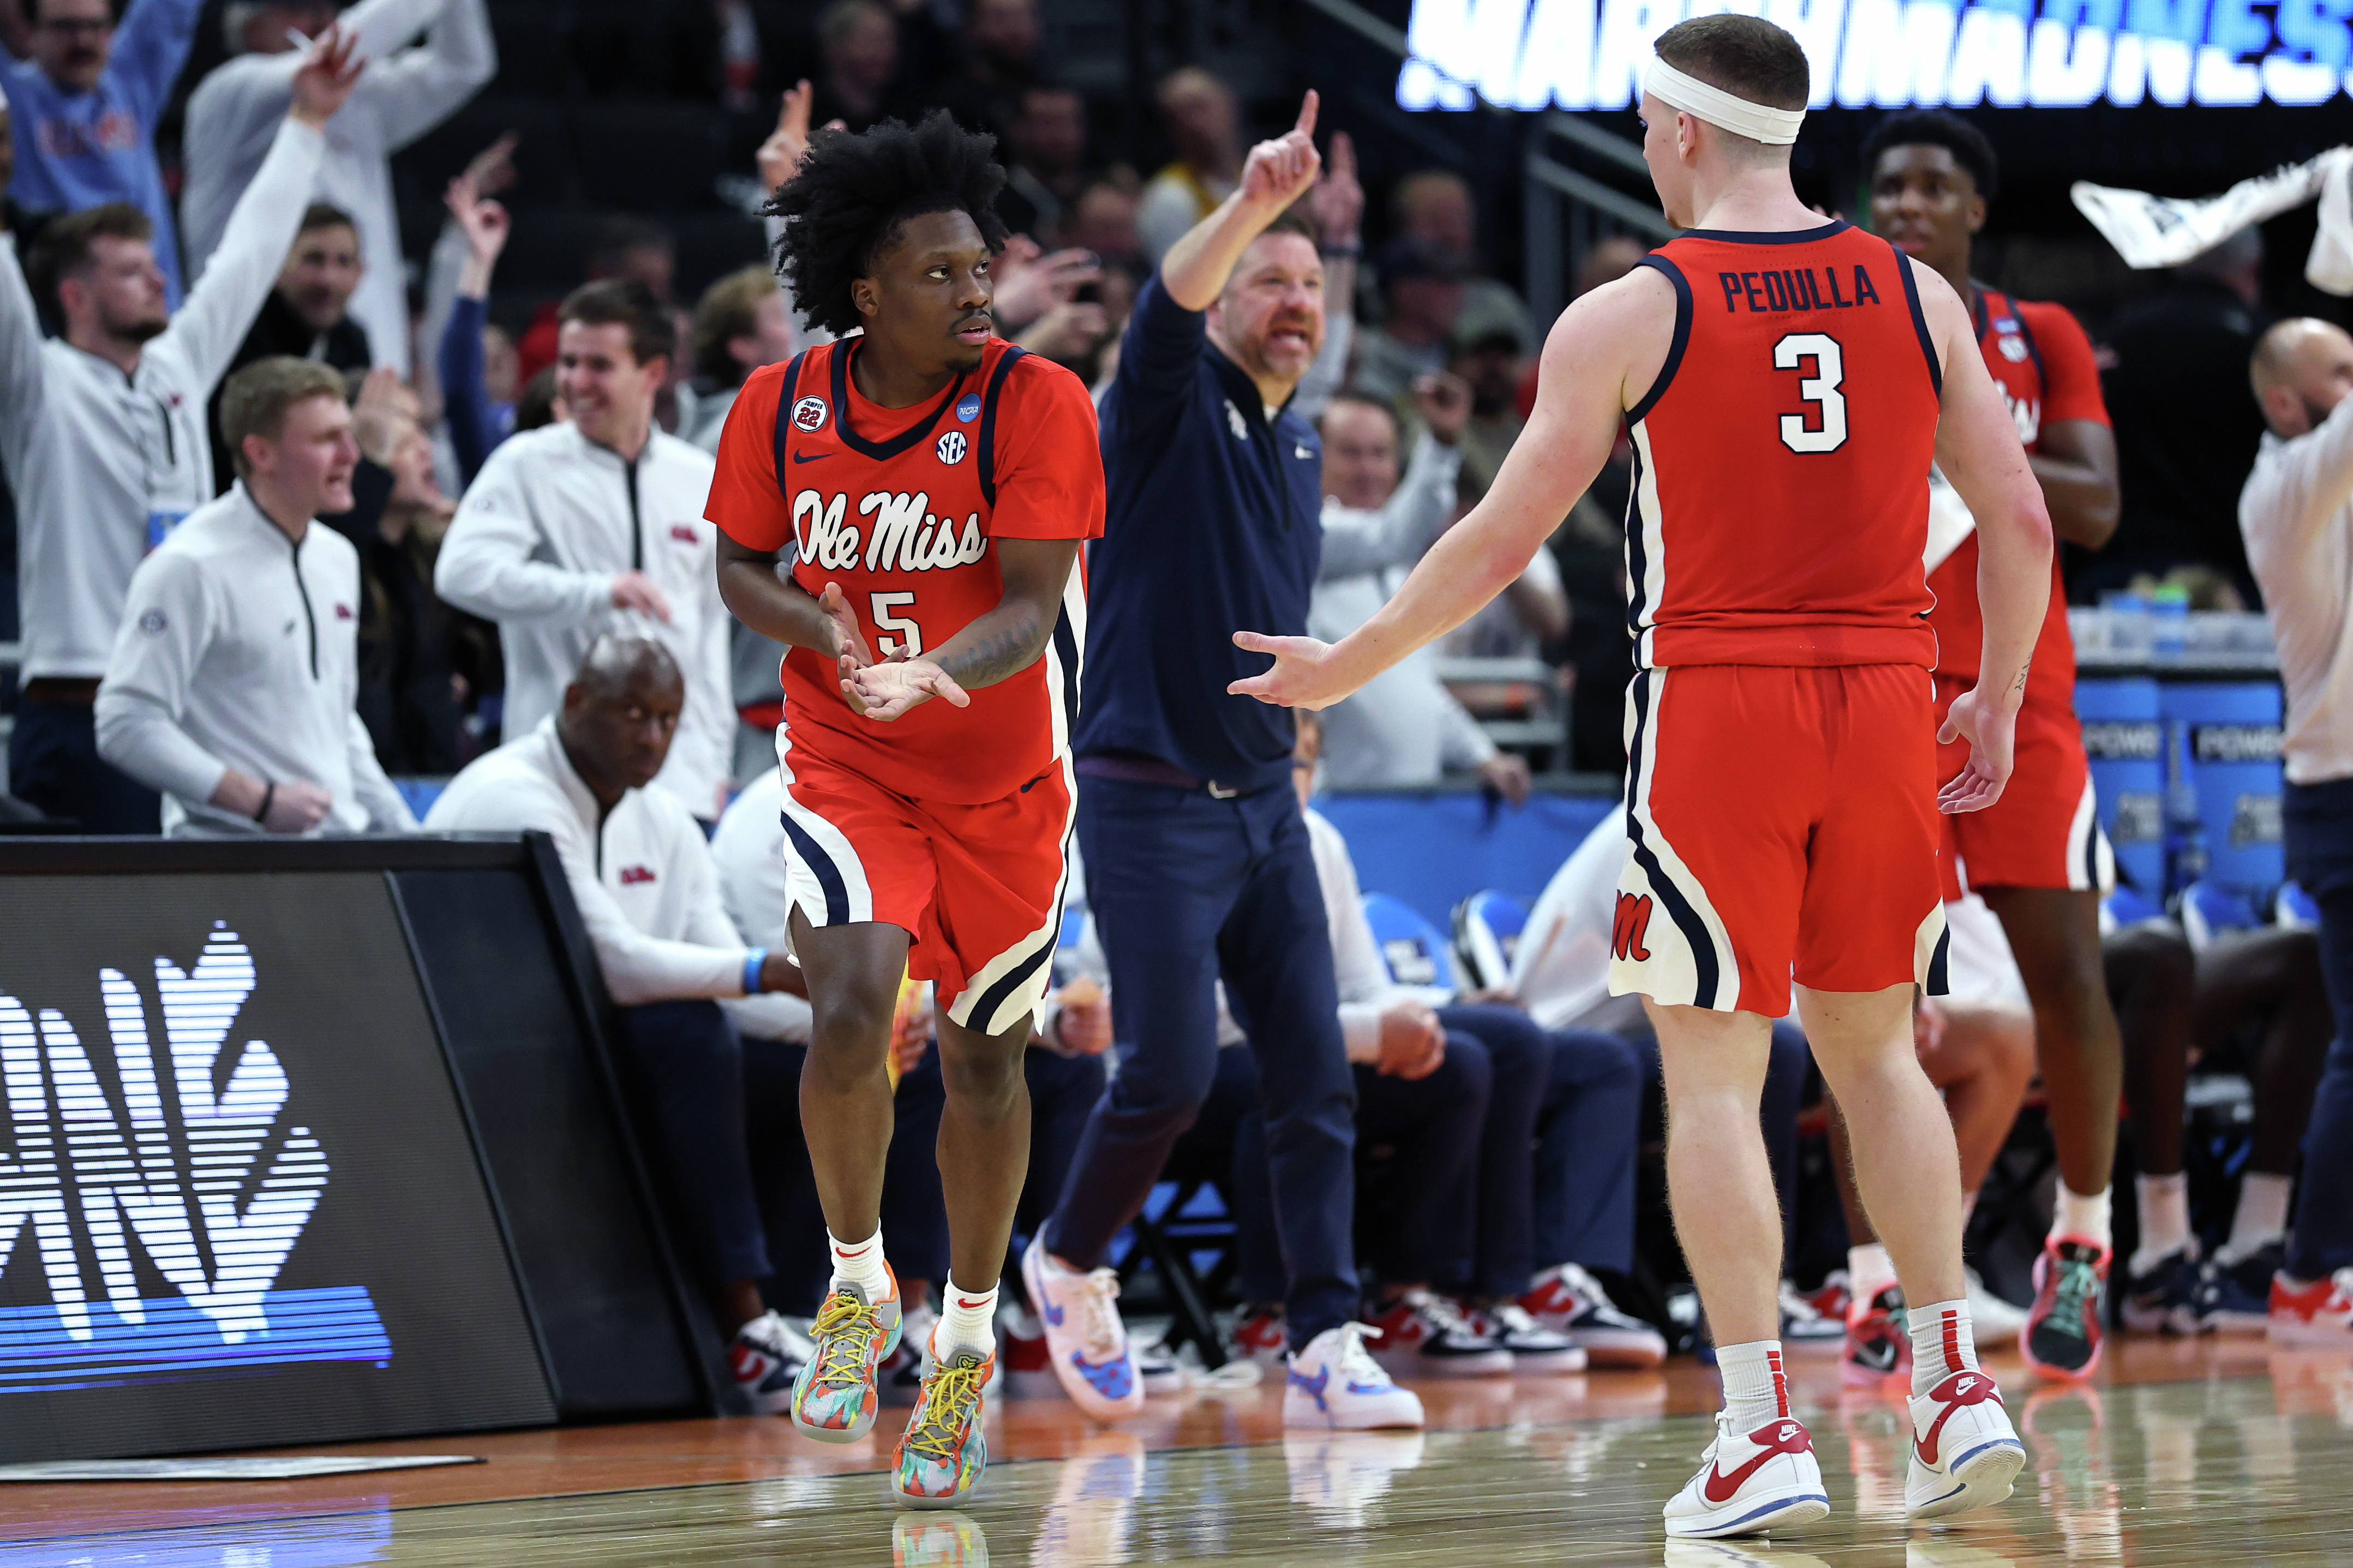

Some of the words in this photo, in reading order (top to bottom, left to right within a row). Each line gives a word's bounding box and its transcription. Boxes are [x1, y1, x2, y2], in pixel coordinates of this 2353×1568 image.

[1719, 265, 1881, 313] PEDULLA
[804, 400, 823, 410] JUMPER
[1773, 332, 1849, 455] 3
[797, 406, 821, 428] 22
[959, 405, 979, 415] NCAA
[937, 431, 967, 465] SEC
[793, 488, 860, 571] Ole
[859, 491, 989, 573] Miss
[870, 591, 923, 659] 5
[1958, 1376, 1975, 1389] NIKE
[1781, 1424, 1797, 1434] NIKE
